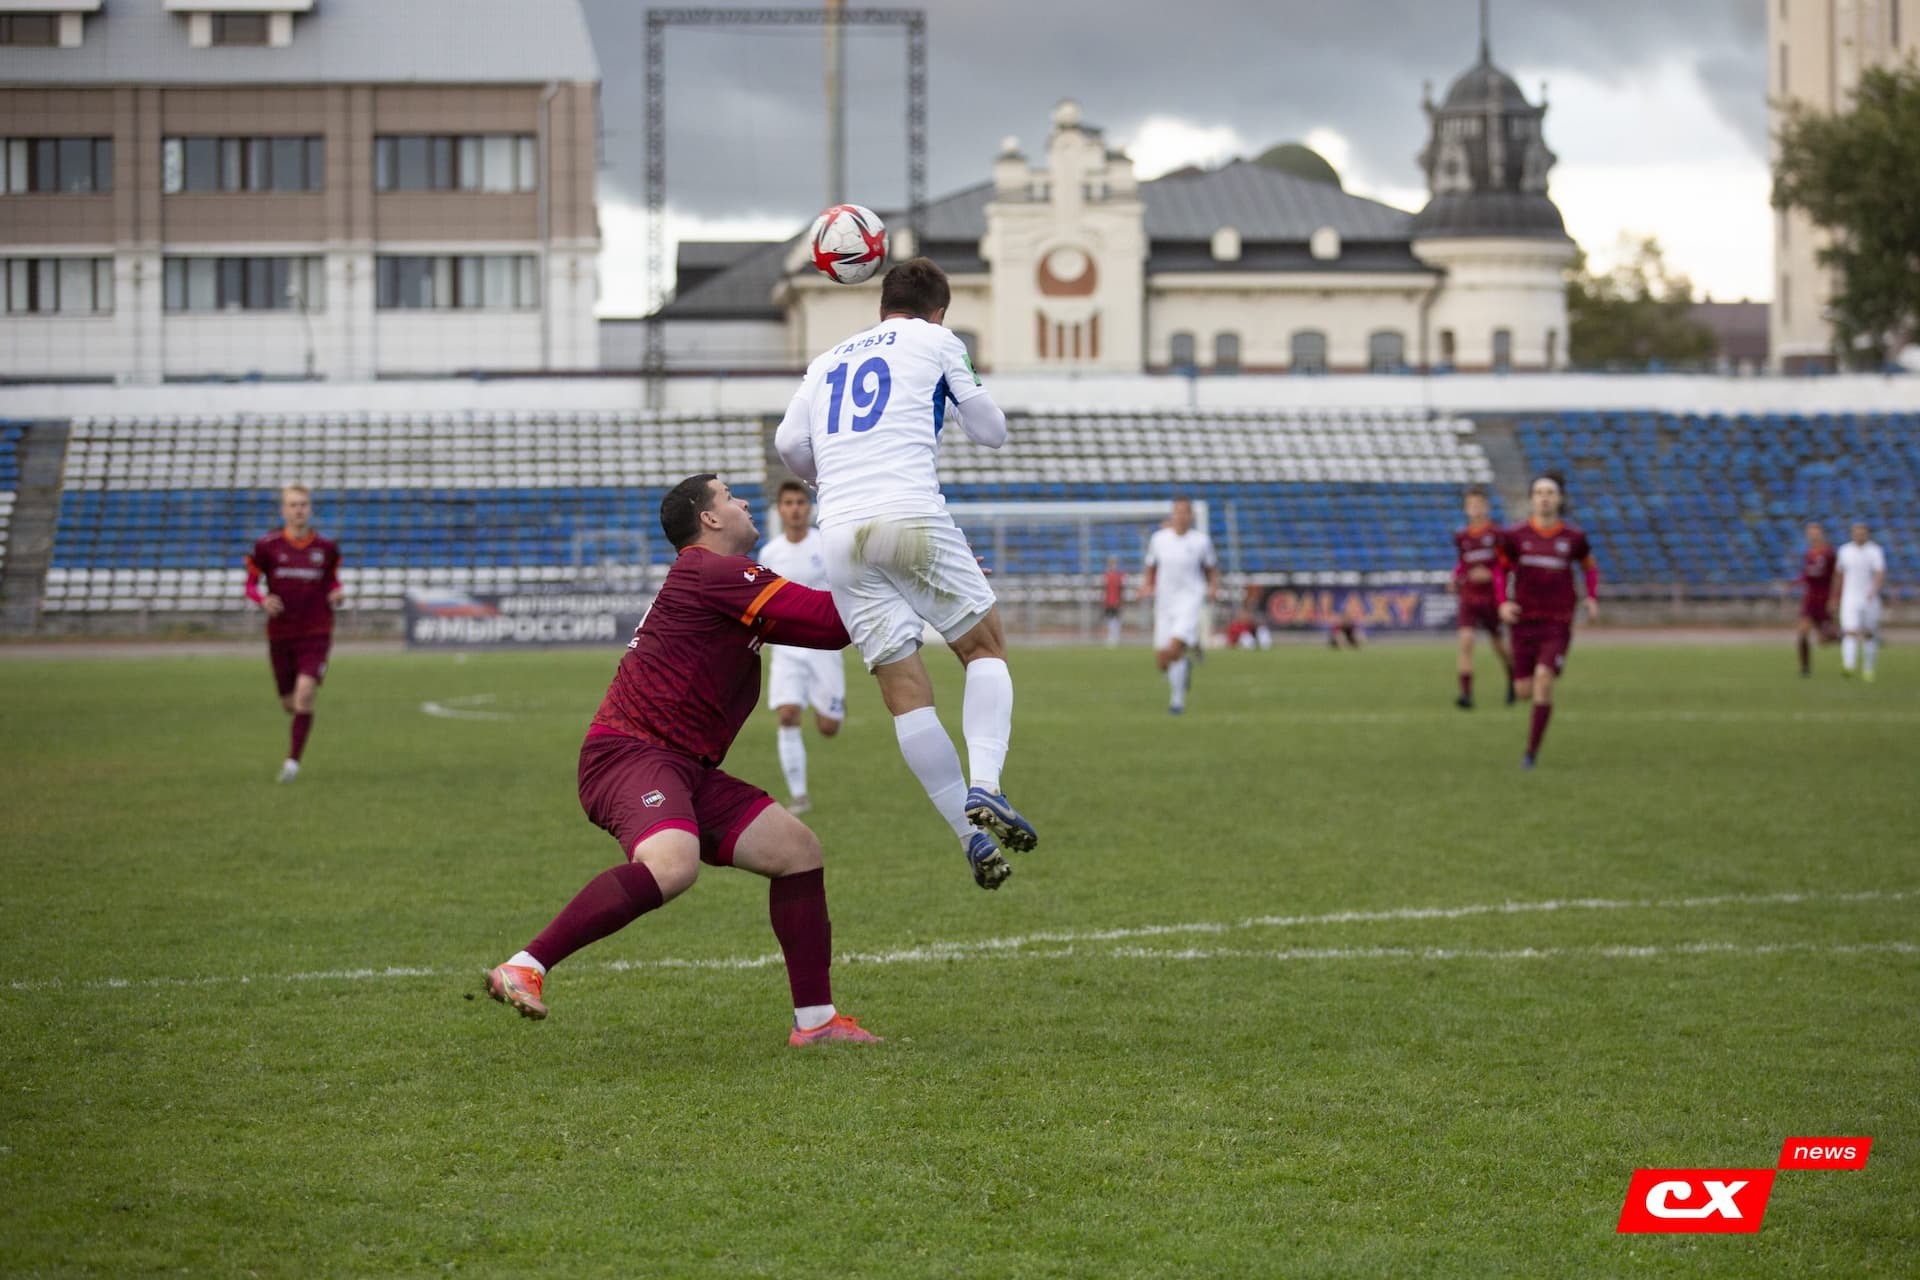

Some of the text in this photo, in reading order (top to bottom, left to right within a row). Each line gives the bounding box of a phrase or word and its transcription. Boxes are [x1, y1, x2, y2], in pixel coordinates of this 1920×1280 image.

[826, 356, 892, 434] 19
[1270, 591, 1417, 624] GALAXY
[415, 616, 617, 643] #МЫРОССИЯ
